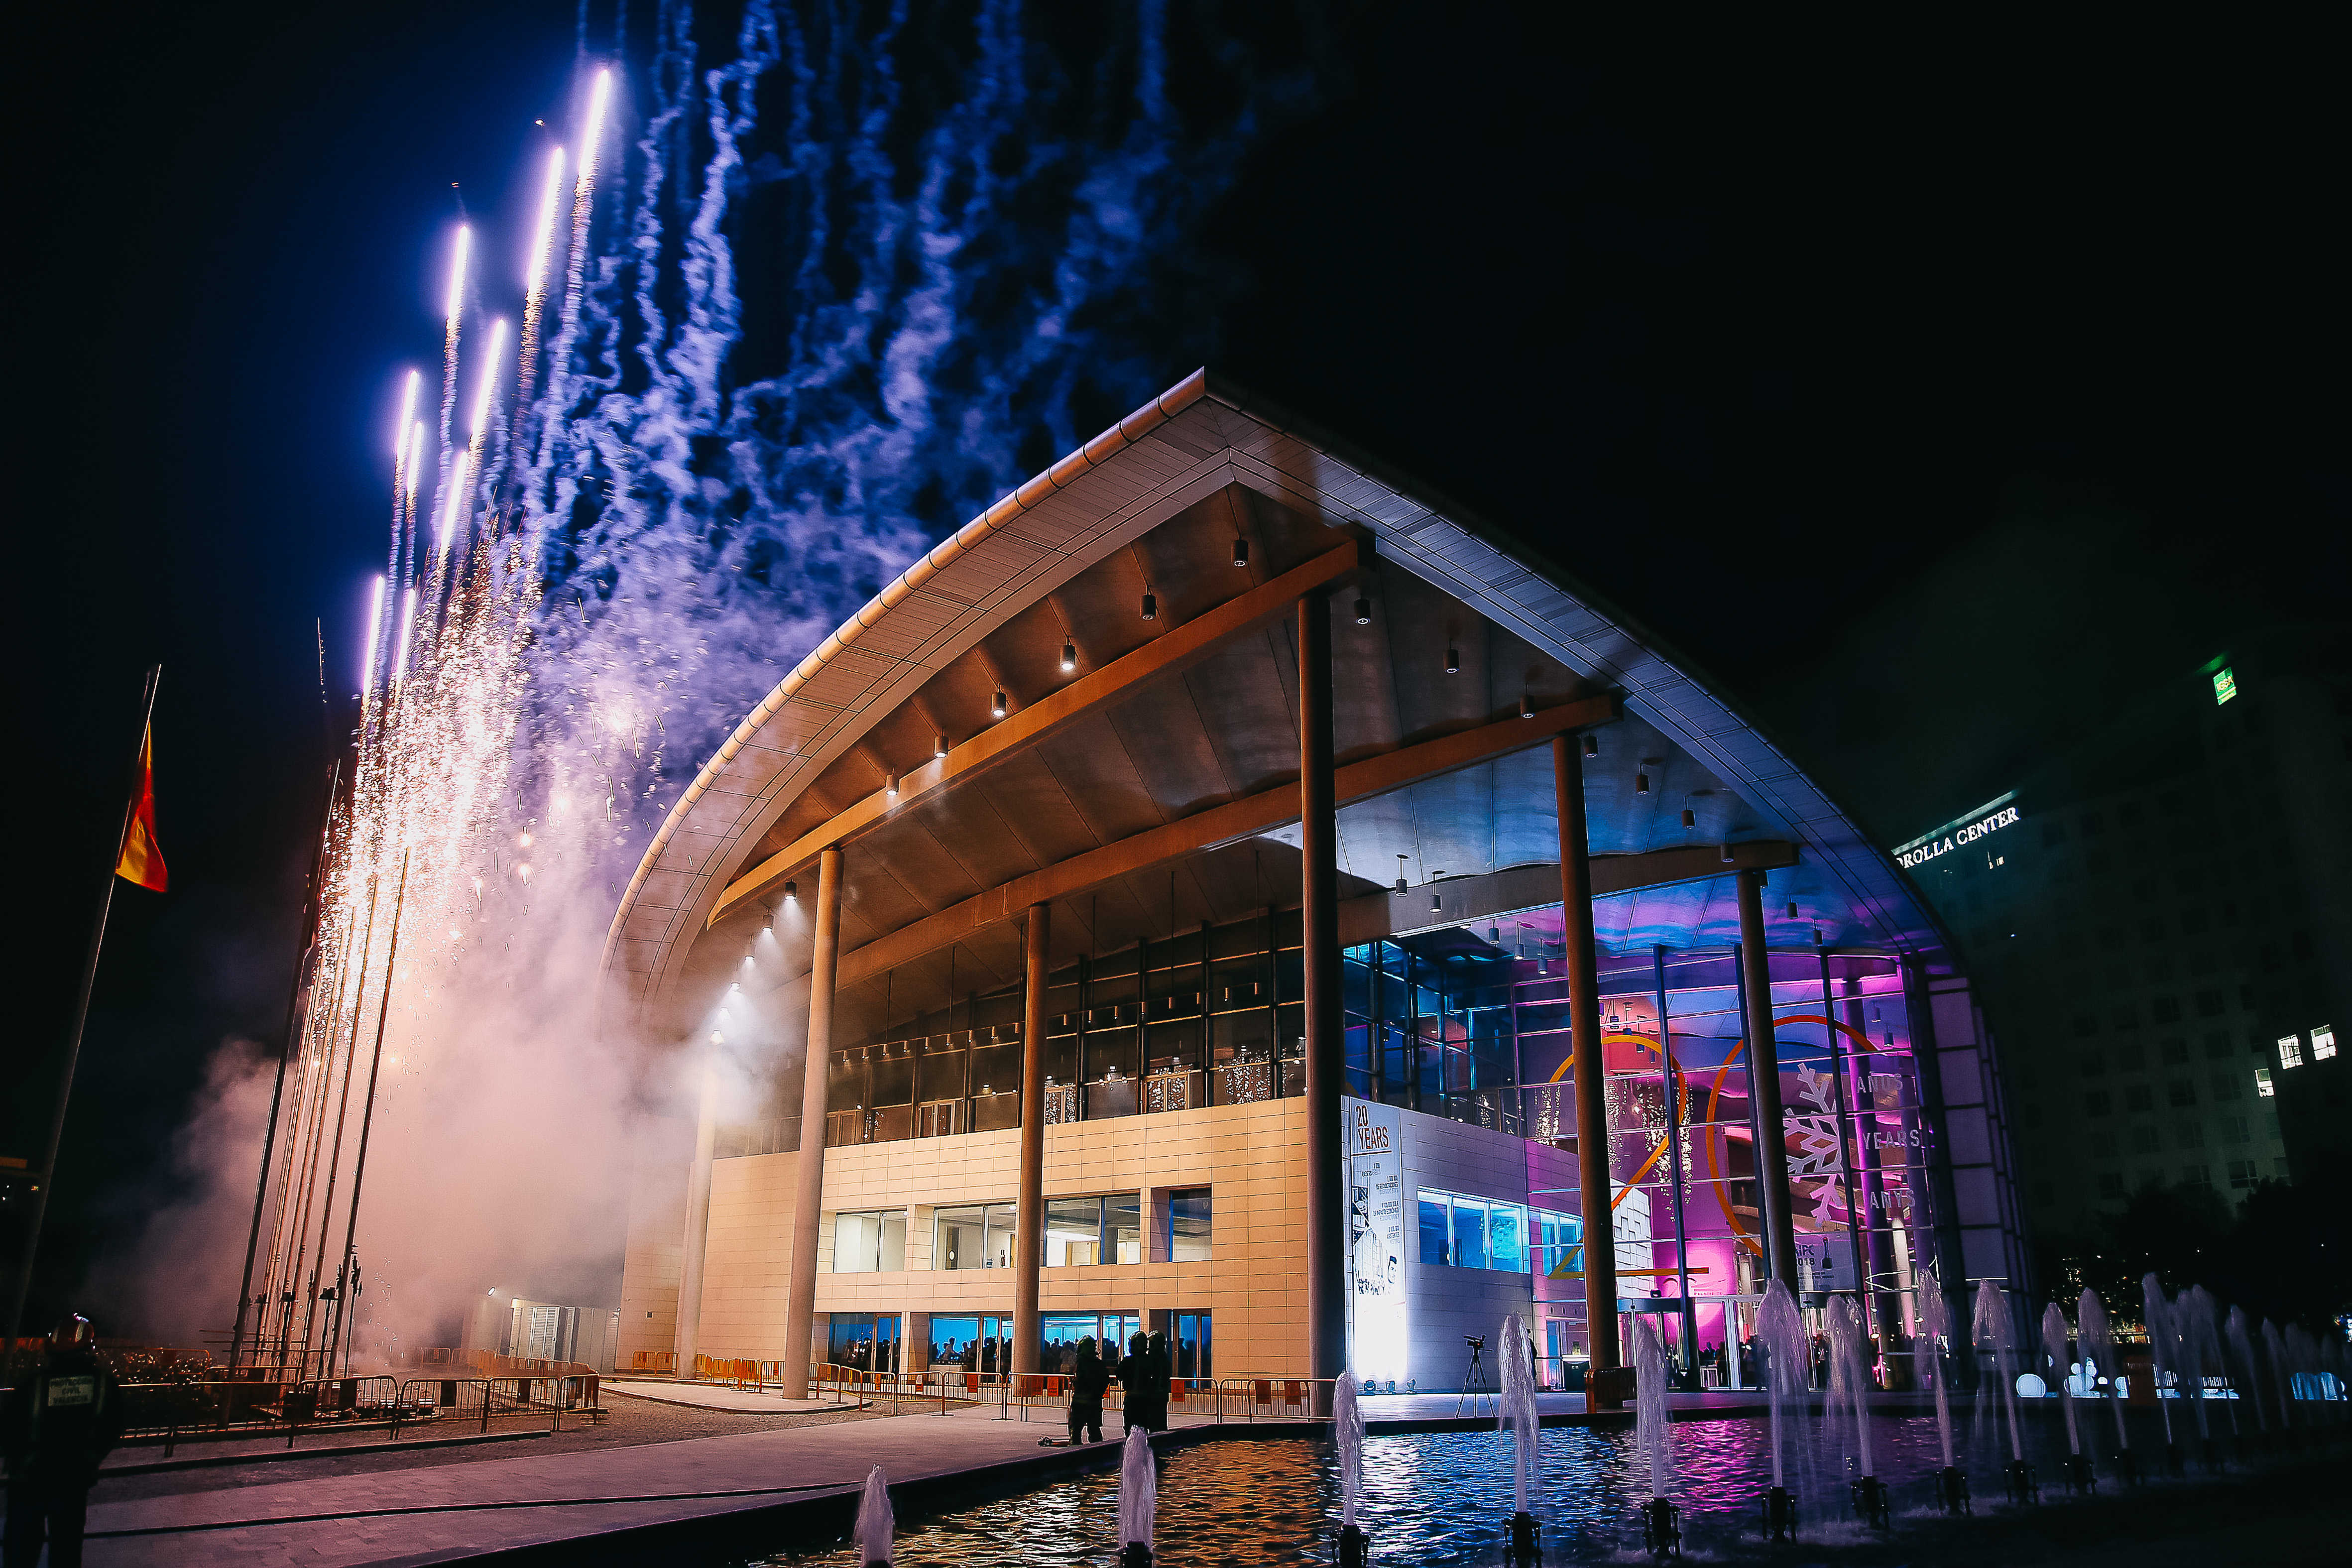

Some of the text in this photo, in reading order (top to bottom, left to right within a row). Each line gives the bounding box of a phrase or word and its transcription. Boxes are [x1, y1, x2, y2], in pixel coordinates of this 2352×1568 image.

[1956, 807, 2019, 845] CENTER
[1356, 1105, 1368, 1126] 20
[1358, 1126, 1389, 1149] YEARS
[1863, 1129, 1920, 1150] YEARS
[1870, 1190, 1915, 1208] ANYS
[1797, 1257, 1815, 1266] 018
